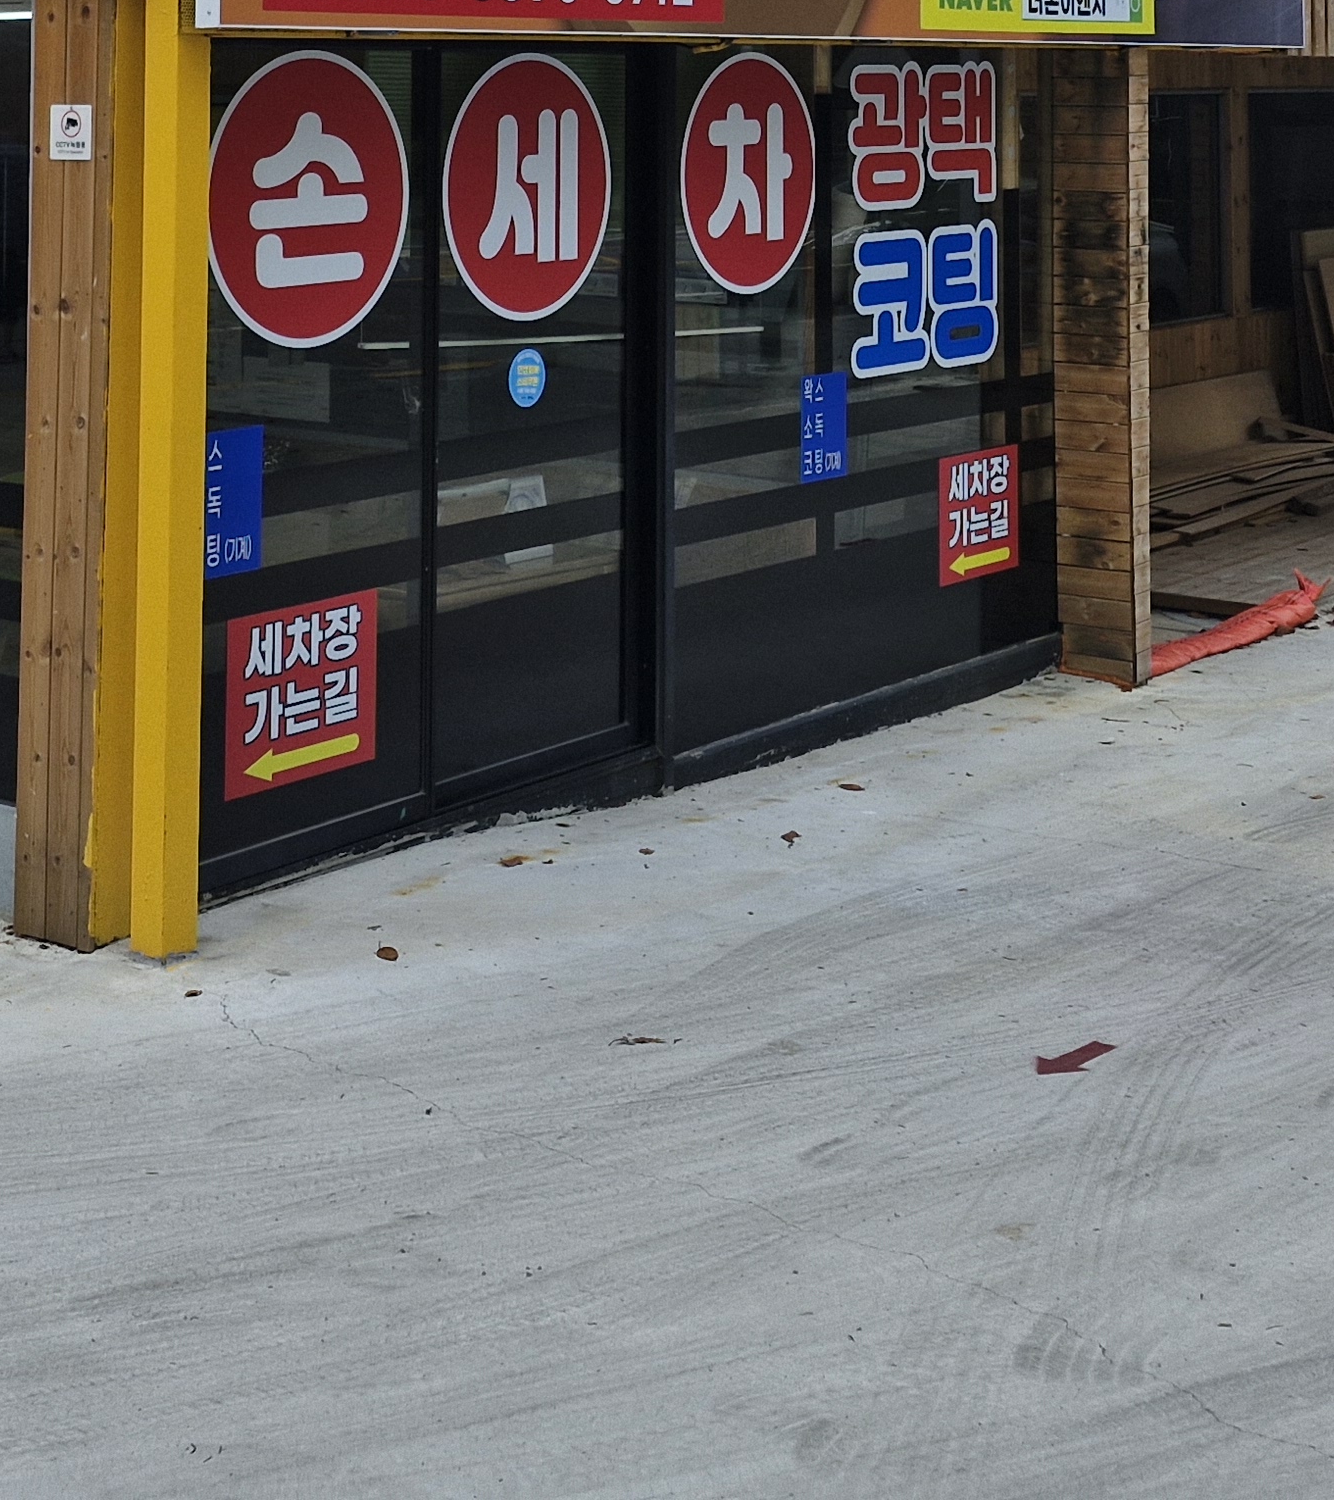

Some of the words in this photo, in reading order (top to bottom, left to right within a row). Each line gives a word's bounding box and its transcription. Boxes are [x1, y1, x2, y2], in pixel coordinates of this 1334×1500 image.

[848, 60, 996, 211] 광택
[249, 112, 369, 289] 손
[478, 109, 578, 263] 세
[708, 102, 793, 242] 차
[850, 218, 999, 379] 코팅
[803, 377, 824, 403] 왁스
[803, 413, 824, 439] 소독
[948, 454, 1010, 502] 세차장
[948, 500, 1009, 549] 가는길
[243, 604, 361, 681] 세차장
[243, 665, 359, 746] 가는길
